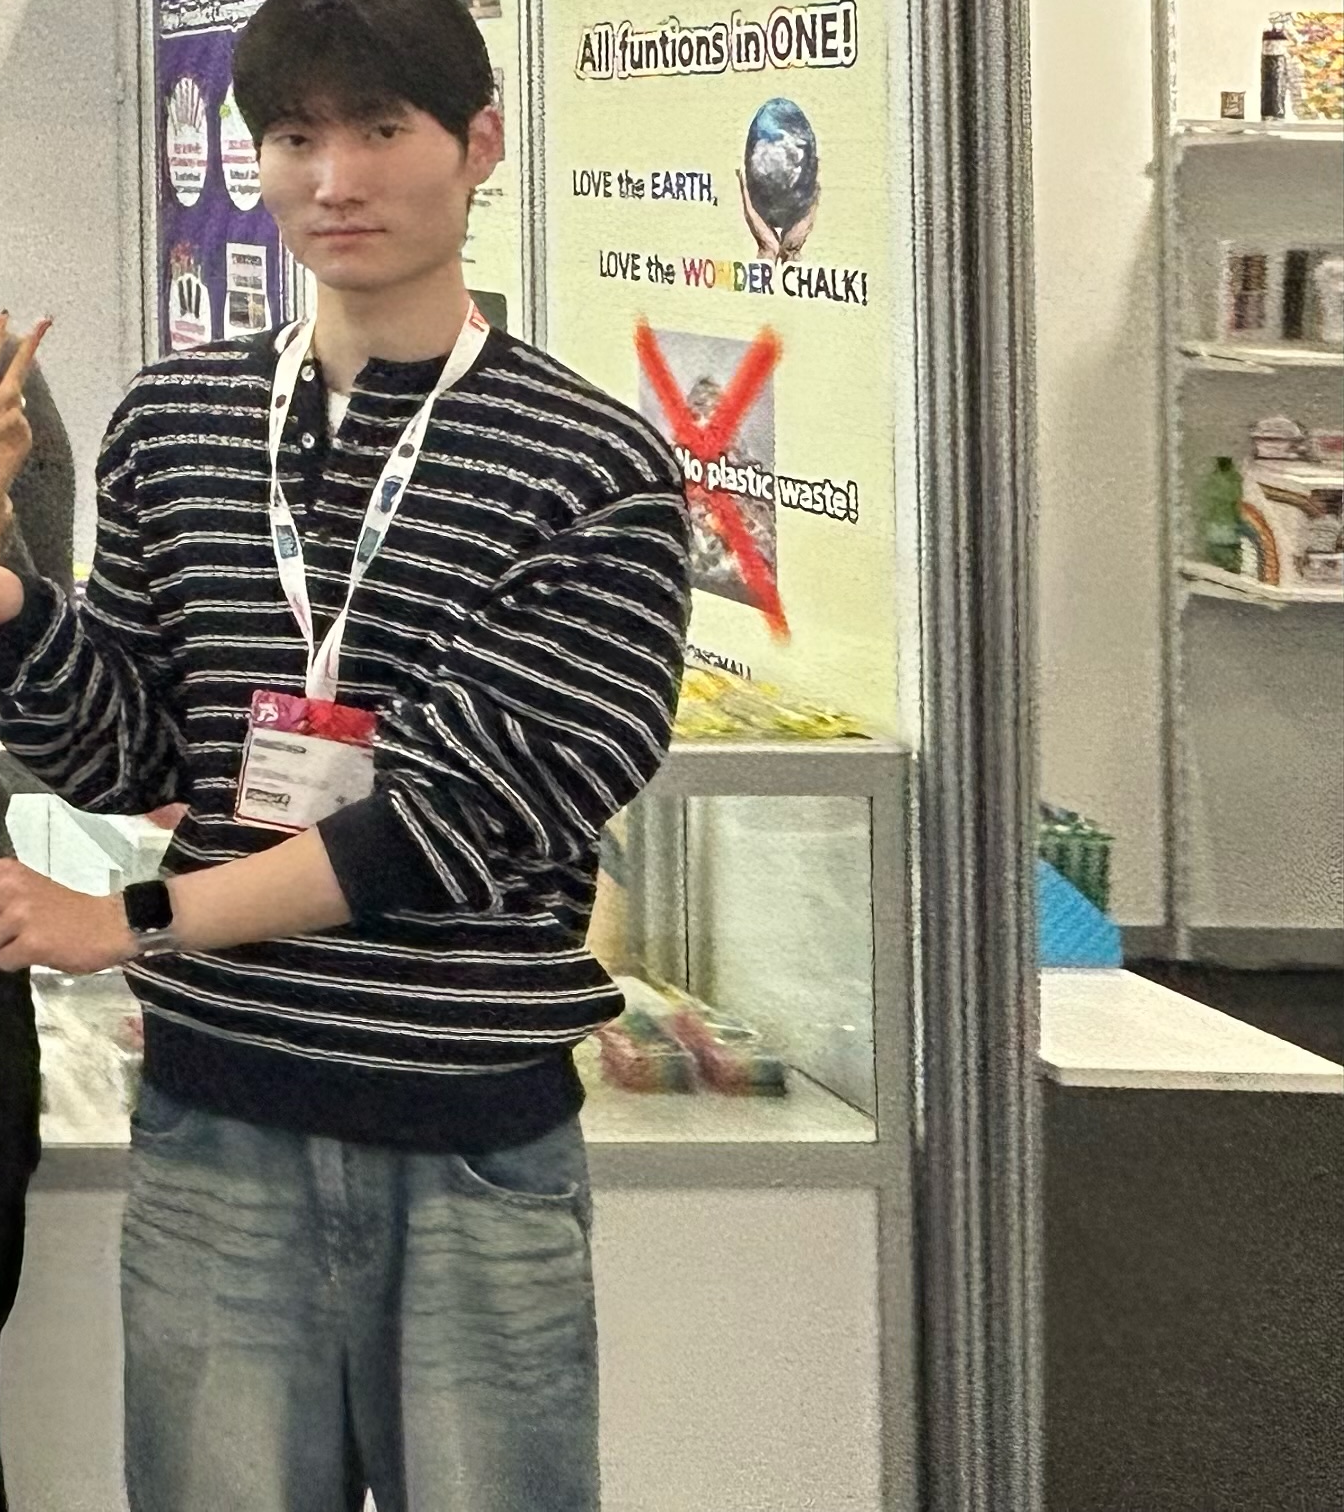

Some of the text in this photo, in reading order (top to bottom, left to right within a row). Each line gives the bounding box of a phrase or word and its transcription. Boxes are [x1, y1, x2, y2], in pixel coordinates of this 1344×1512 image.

[579, 7, 852, 73] All funtions in ONE!
[572, 168, 718, 206] LOVE the EARTH,
[599, 250, 869, 306] LOVE the WONDER CHALK!
[707, 455, 776, 501] plastic
[778, 478, 859, 524] waste!
